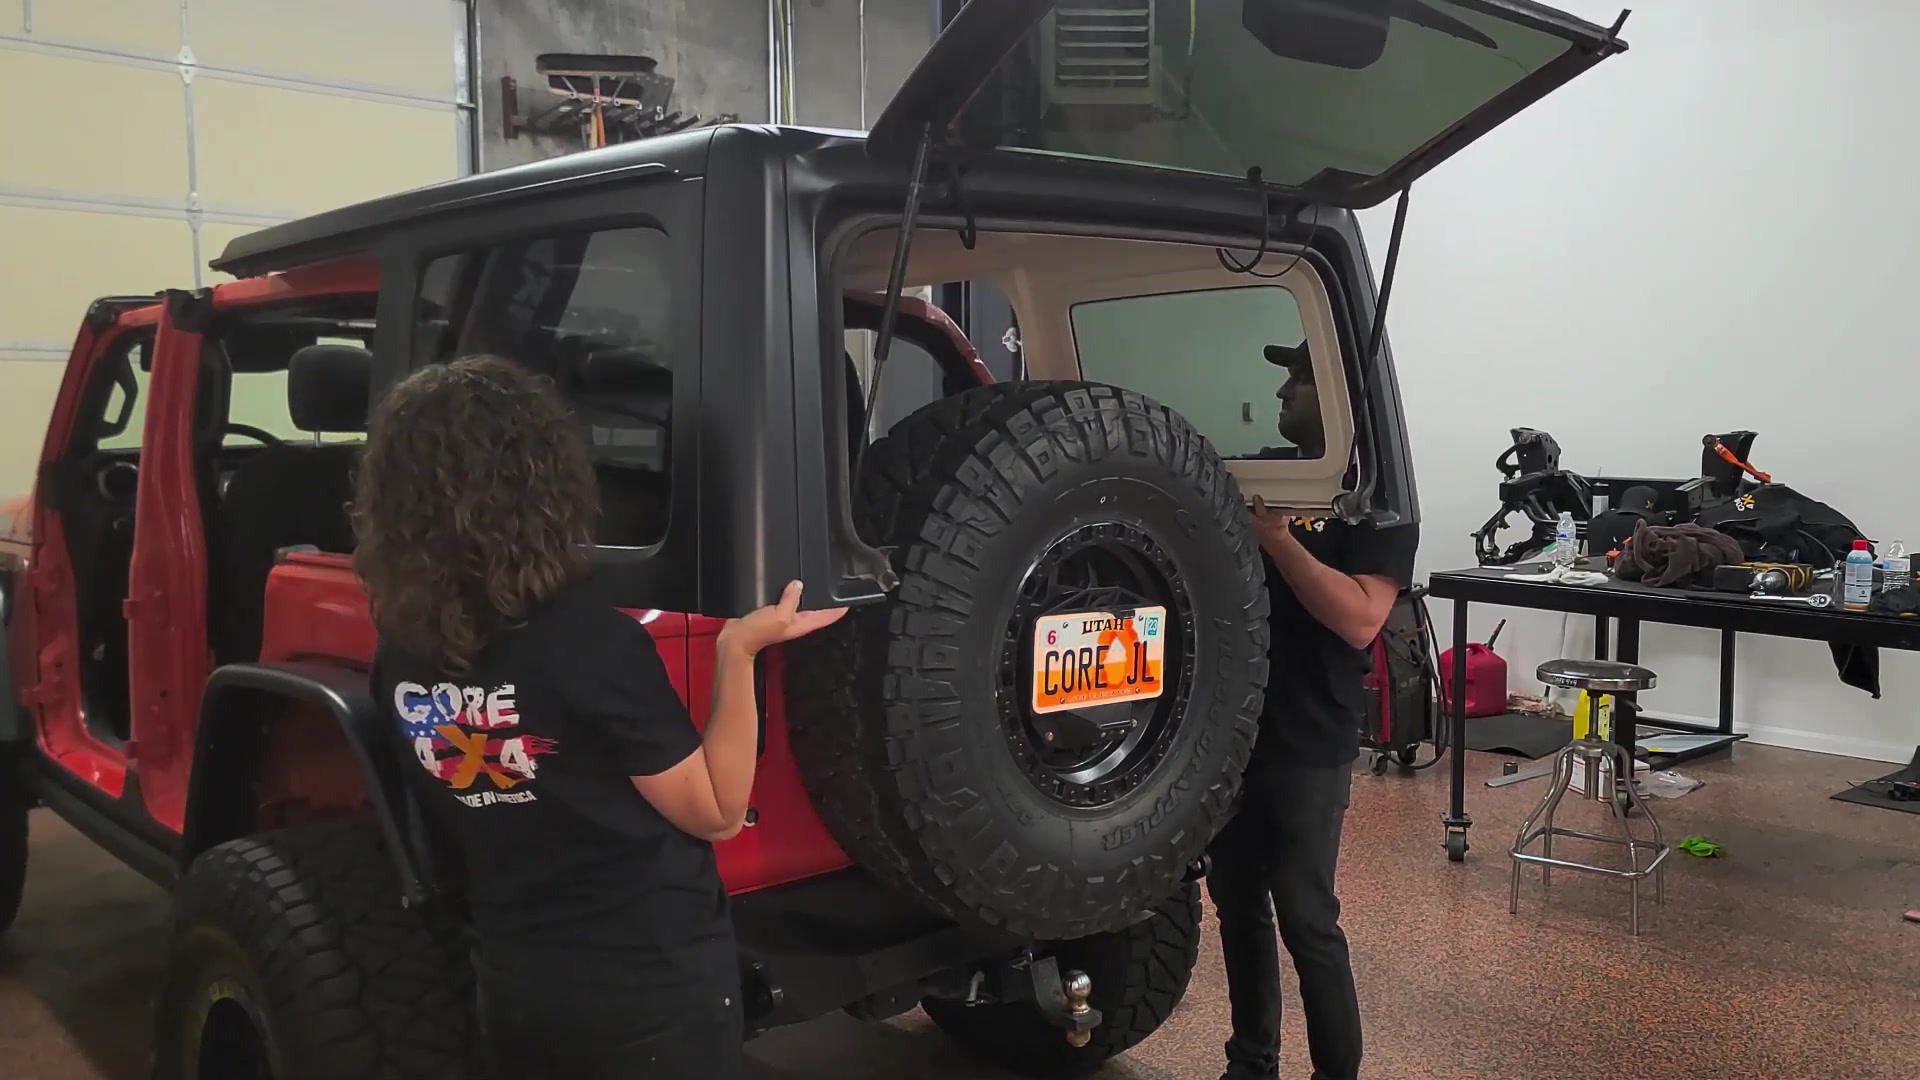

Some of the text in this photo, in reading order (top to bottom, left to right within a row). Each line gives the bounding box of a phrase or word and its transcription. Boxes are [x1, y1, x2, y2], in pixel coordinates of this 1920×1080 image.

[1081, 618, 1124, 634] UTAH
[1047, 630, 1057, 645] 6
[1044, 645, 1110, 696] CORE
[1126, 640, 1155, 685] JL
[482, 791, 497, 806] IN
